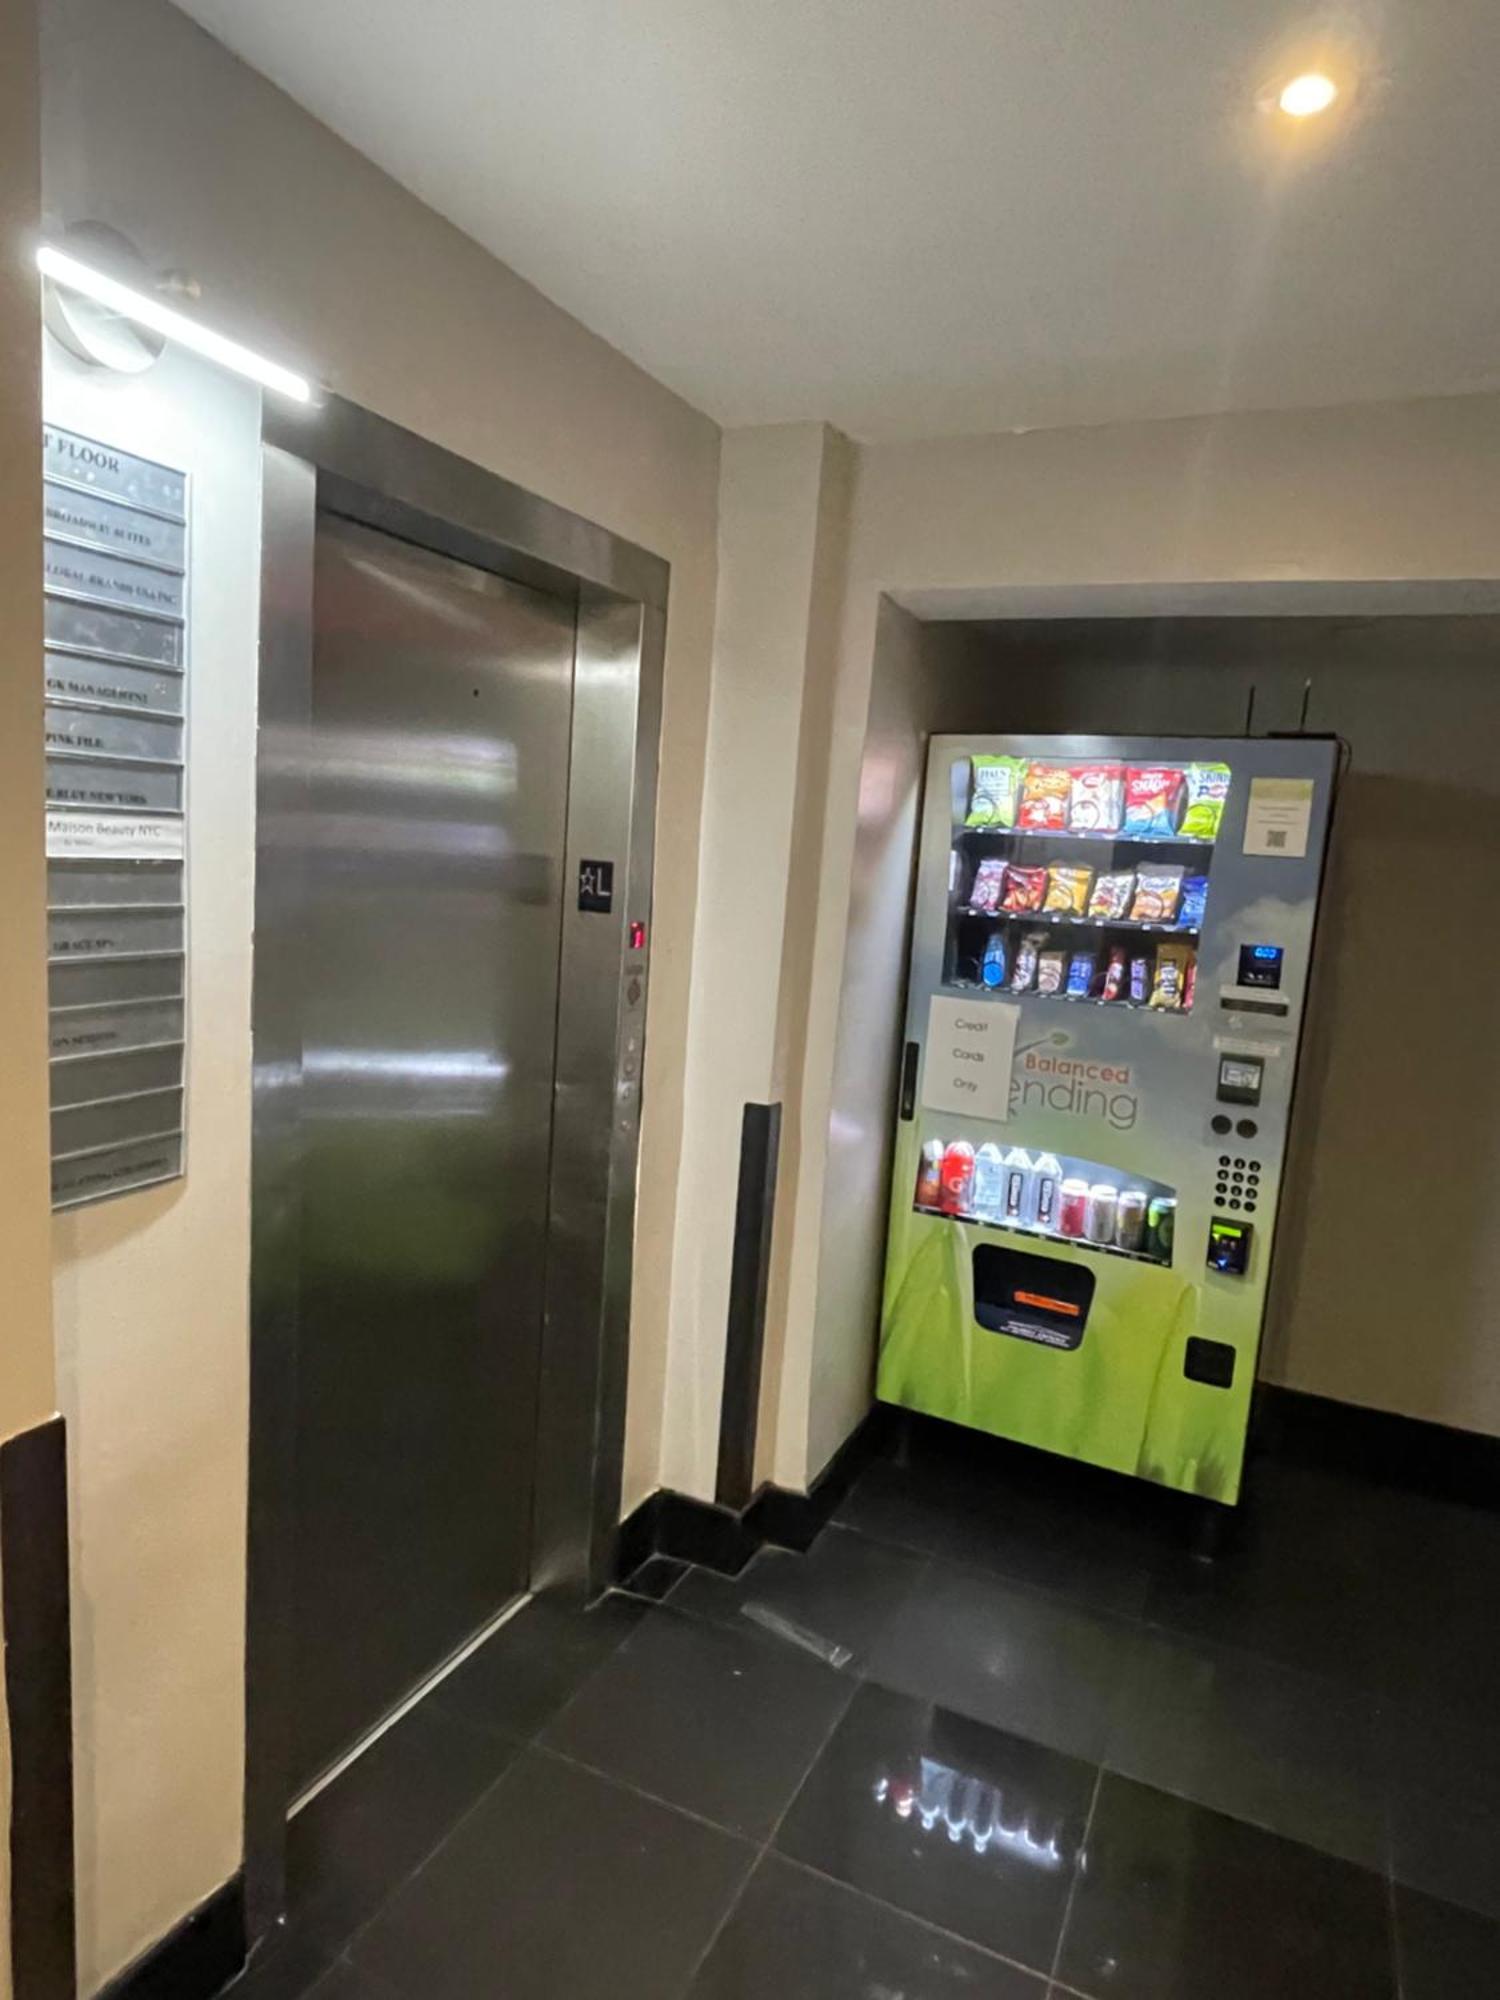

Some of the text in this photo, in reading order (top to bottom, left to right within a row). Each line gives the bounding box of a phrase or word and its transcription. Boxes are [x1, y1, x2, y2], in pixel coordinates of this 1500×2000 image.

[57, 438, 120, 473] FLOOR
[48, 820, 161, 838] Maison Beauty NYC
[596, 867, 612, 896] L
[954, 1018, 989, 1032] Credit
[952, 1047, 985, 1062] Cards
[1024, 1052, 1130, 1084] Balanced
[953, 1077, 979, 1093] Only
